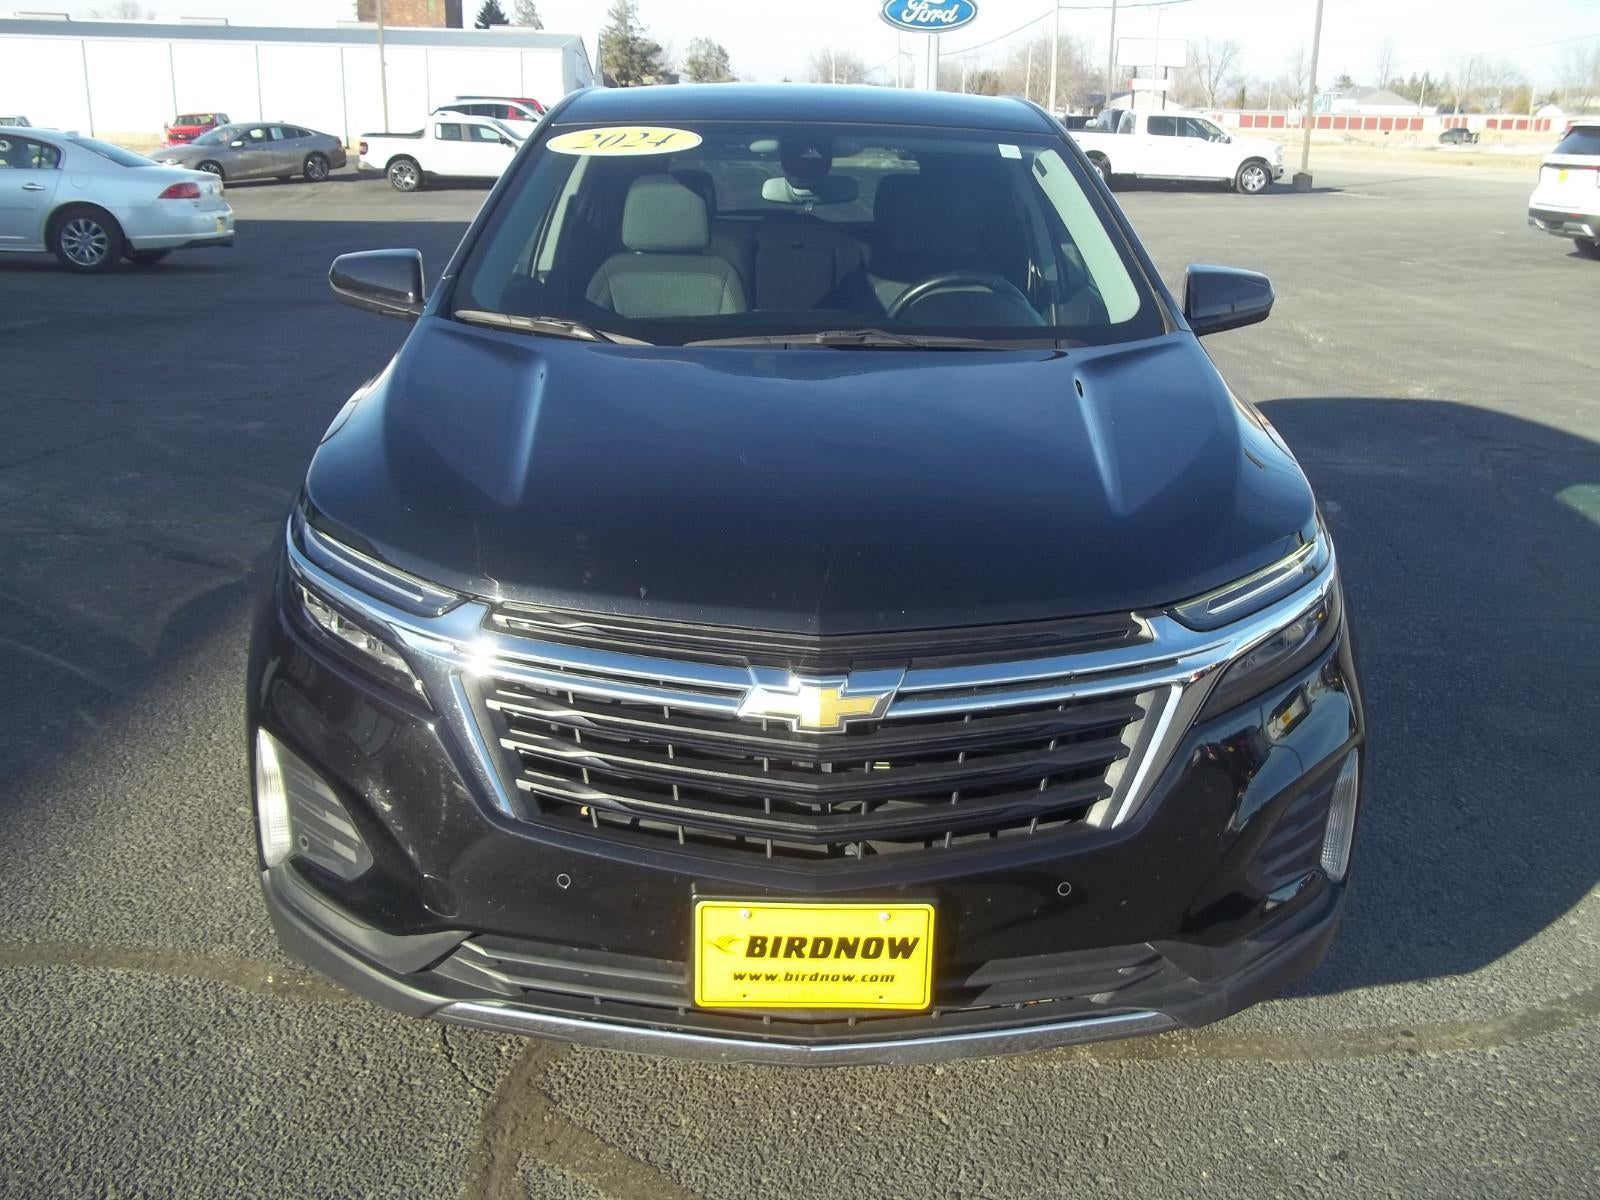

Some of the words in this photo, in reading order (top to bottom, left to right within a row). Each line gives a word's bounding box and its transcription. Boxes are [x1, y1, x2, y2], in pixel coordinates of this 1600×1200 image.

[901, 0, 960, 23] Ford
[572, 132, 678, 150] 2024
[745, 935, 920, 960] BIRDNOW
[732, 971, 896, 983] www.birdnow.com
